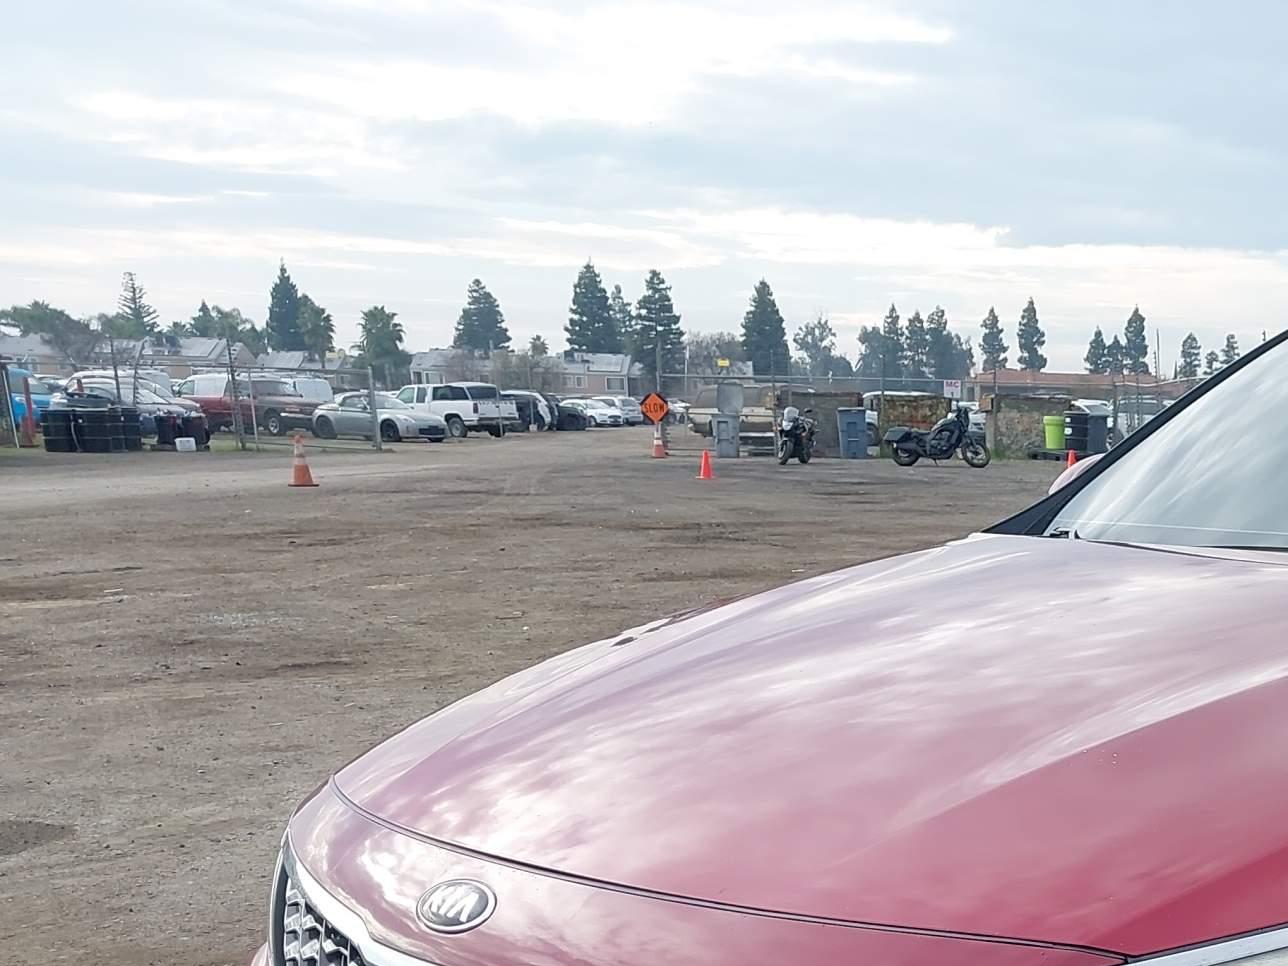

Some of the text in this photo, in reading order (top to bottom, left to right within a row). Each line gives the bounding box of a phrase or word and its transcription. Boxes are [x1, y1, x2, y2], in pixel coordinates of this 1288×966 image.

[945, 380, 960, 389] MC
[643, 402, 666, 413] SLOW
[422, 885, 480, 923] KIA
